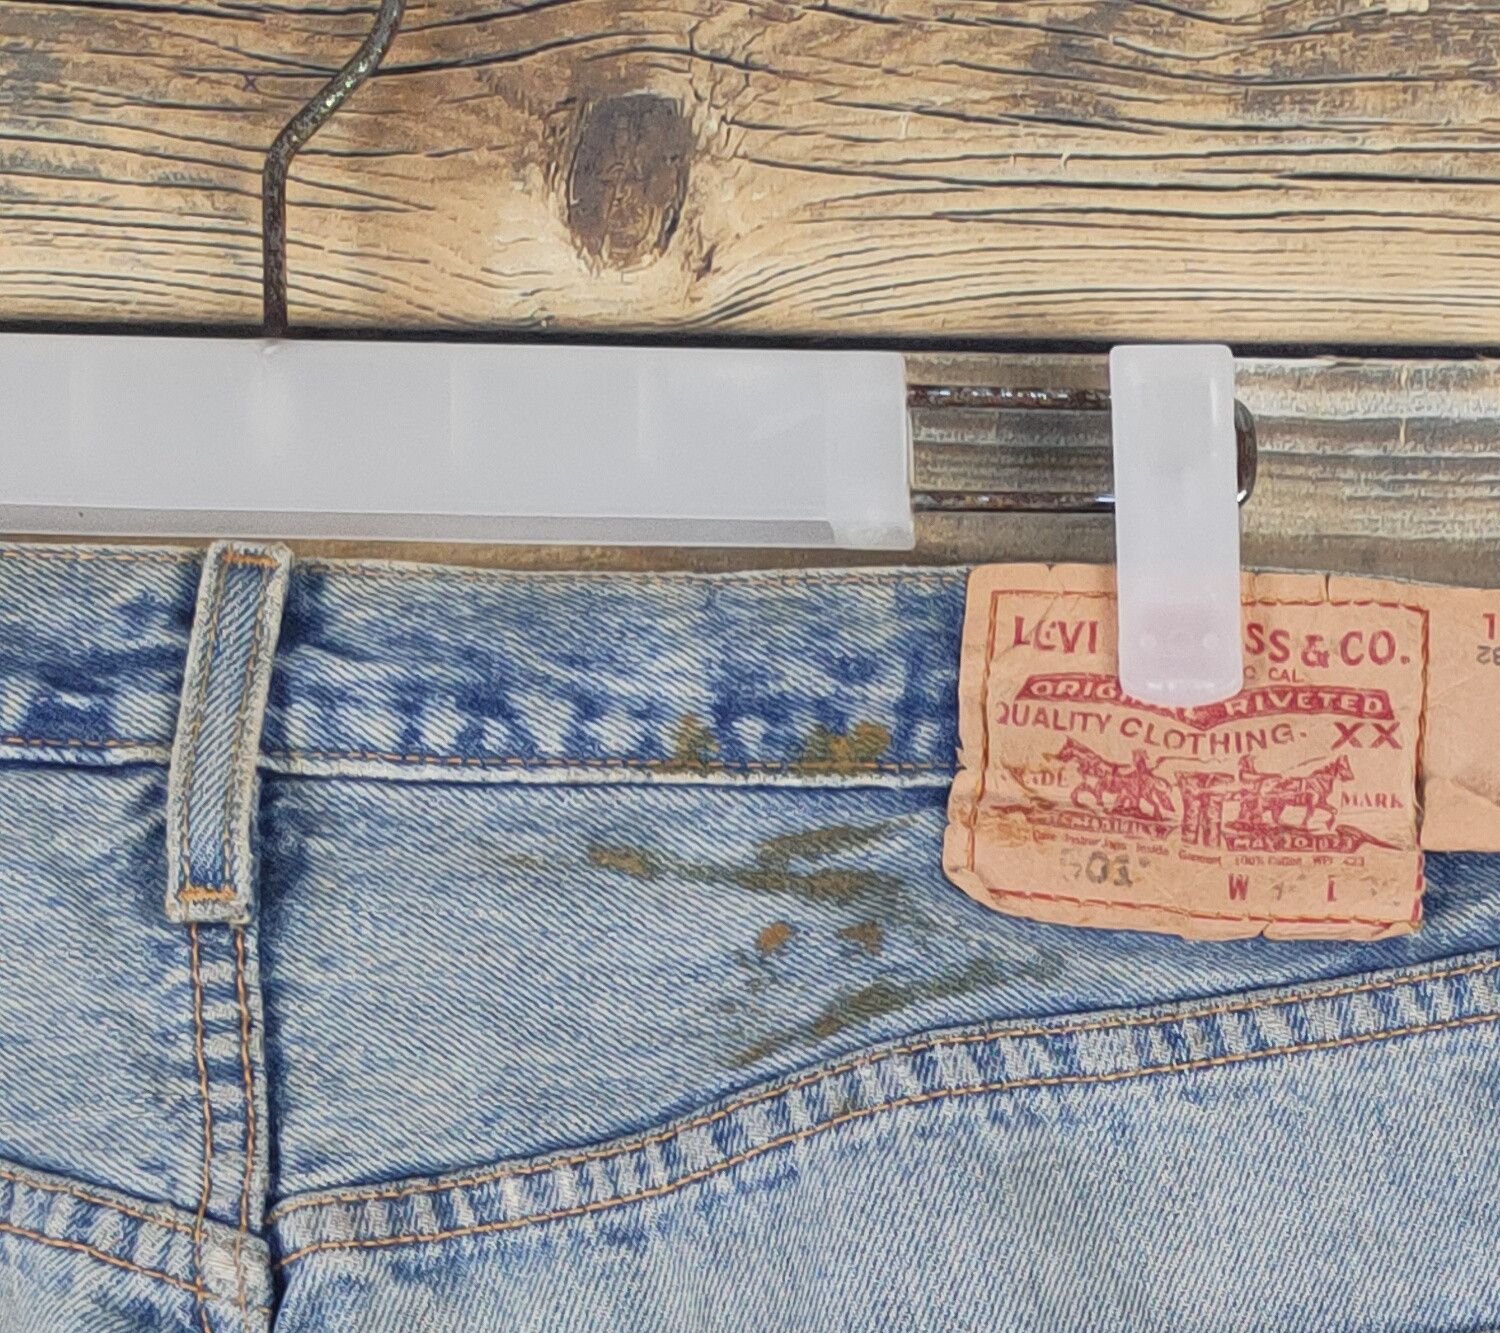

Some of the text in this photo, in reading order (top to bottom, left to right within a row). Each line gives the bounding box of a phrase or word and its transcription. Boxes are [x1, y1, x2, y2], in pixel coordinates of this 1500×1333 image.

[1482, 612, 1496, 641] L
[1300, 634, 1330, 668] &
[1339, 630, 1411, 666] CO.
[1224, 689, 1385, 716] RIVETED
[995, 701, 1113, 735] QUALITY
[1330, 721, 1403, 751] XX
[1340, 791, 1405, 809] MARK
